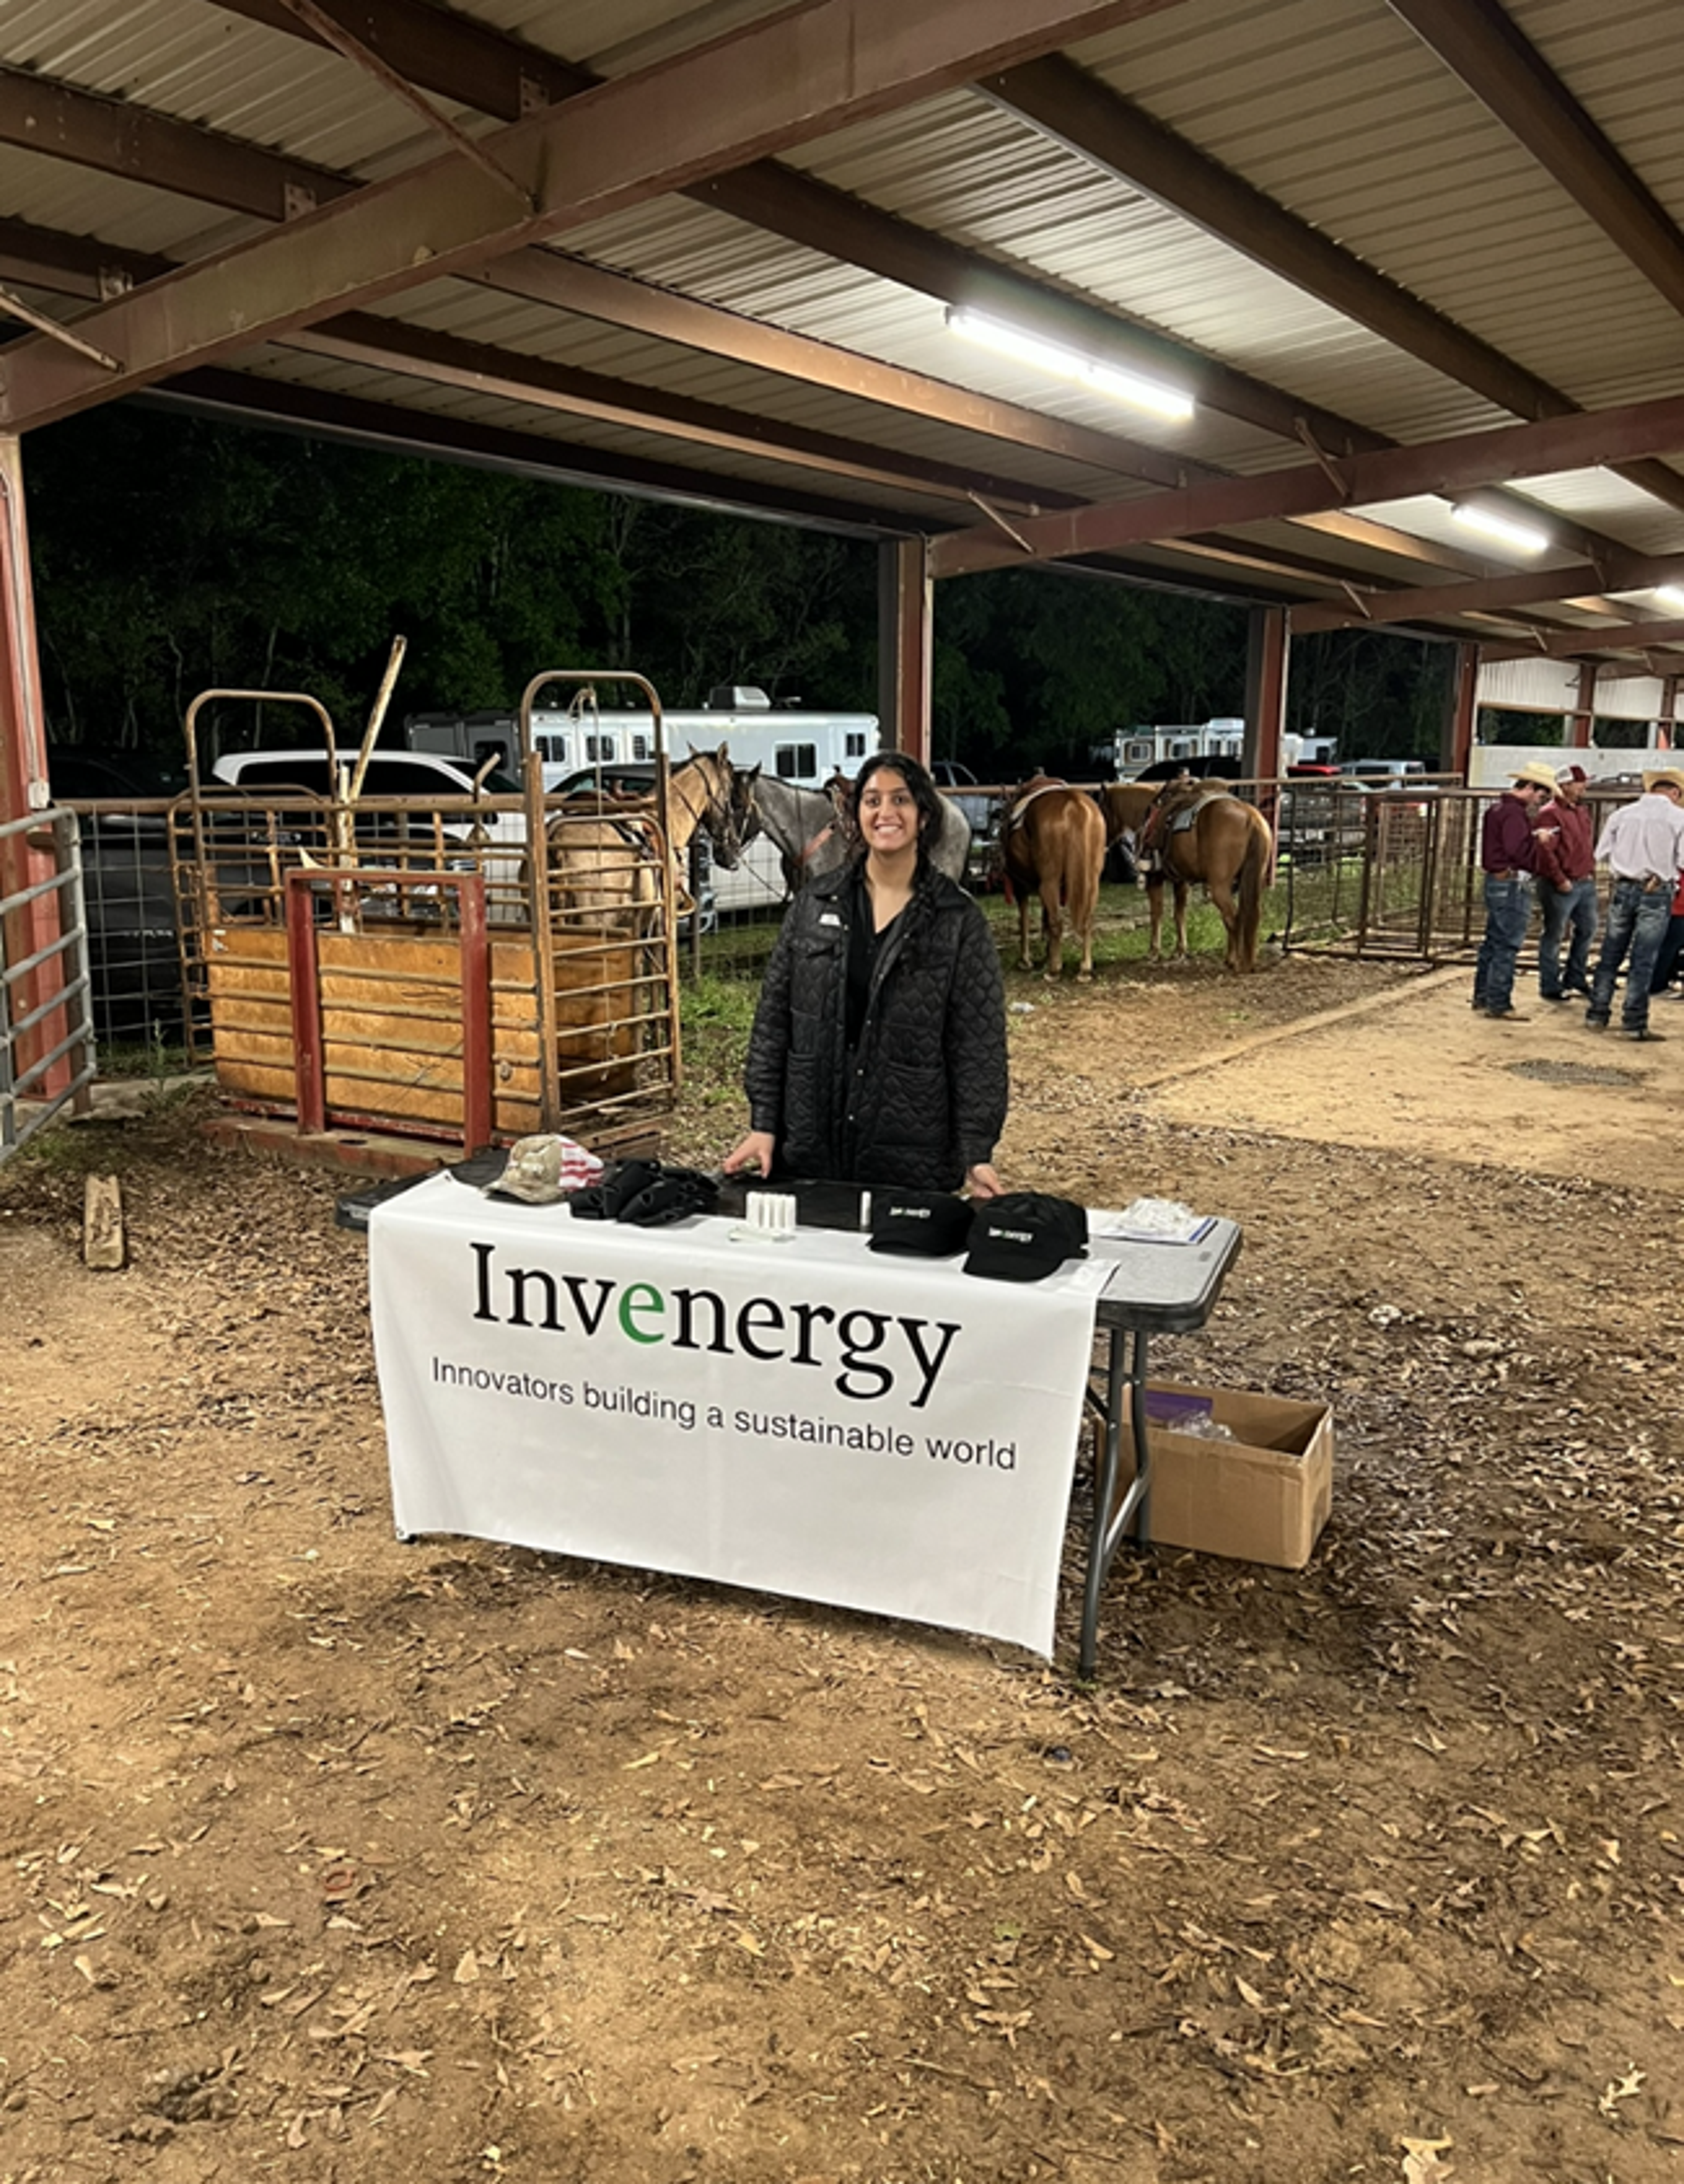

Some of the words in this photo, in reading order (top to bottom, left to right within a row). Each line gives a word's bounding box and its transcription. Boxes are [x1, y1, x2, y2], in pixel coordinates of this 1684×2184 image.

[470, 1243, 961, 1407] Invenergy
[433, 1357, 574, 1404] Innovators
[585, 1383, 695, 1430] building
[707, 1407, 723, 1427] a
[735, 1411, 913, 1456] sustainable
[926, 1439, 1015, 1469] world
